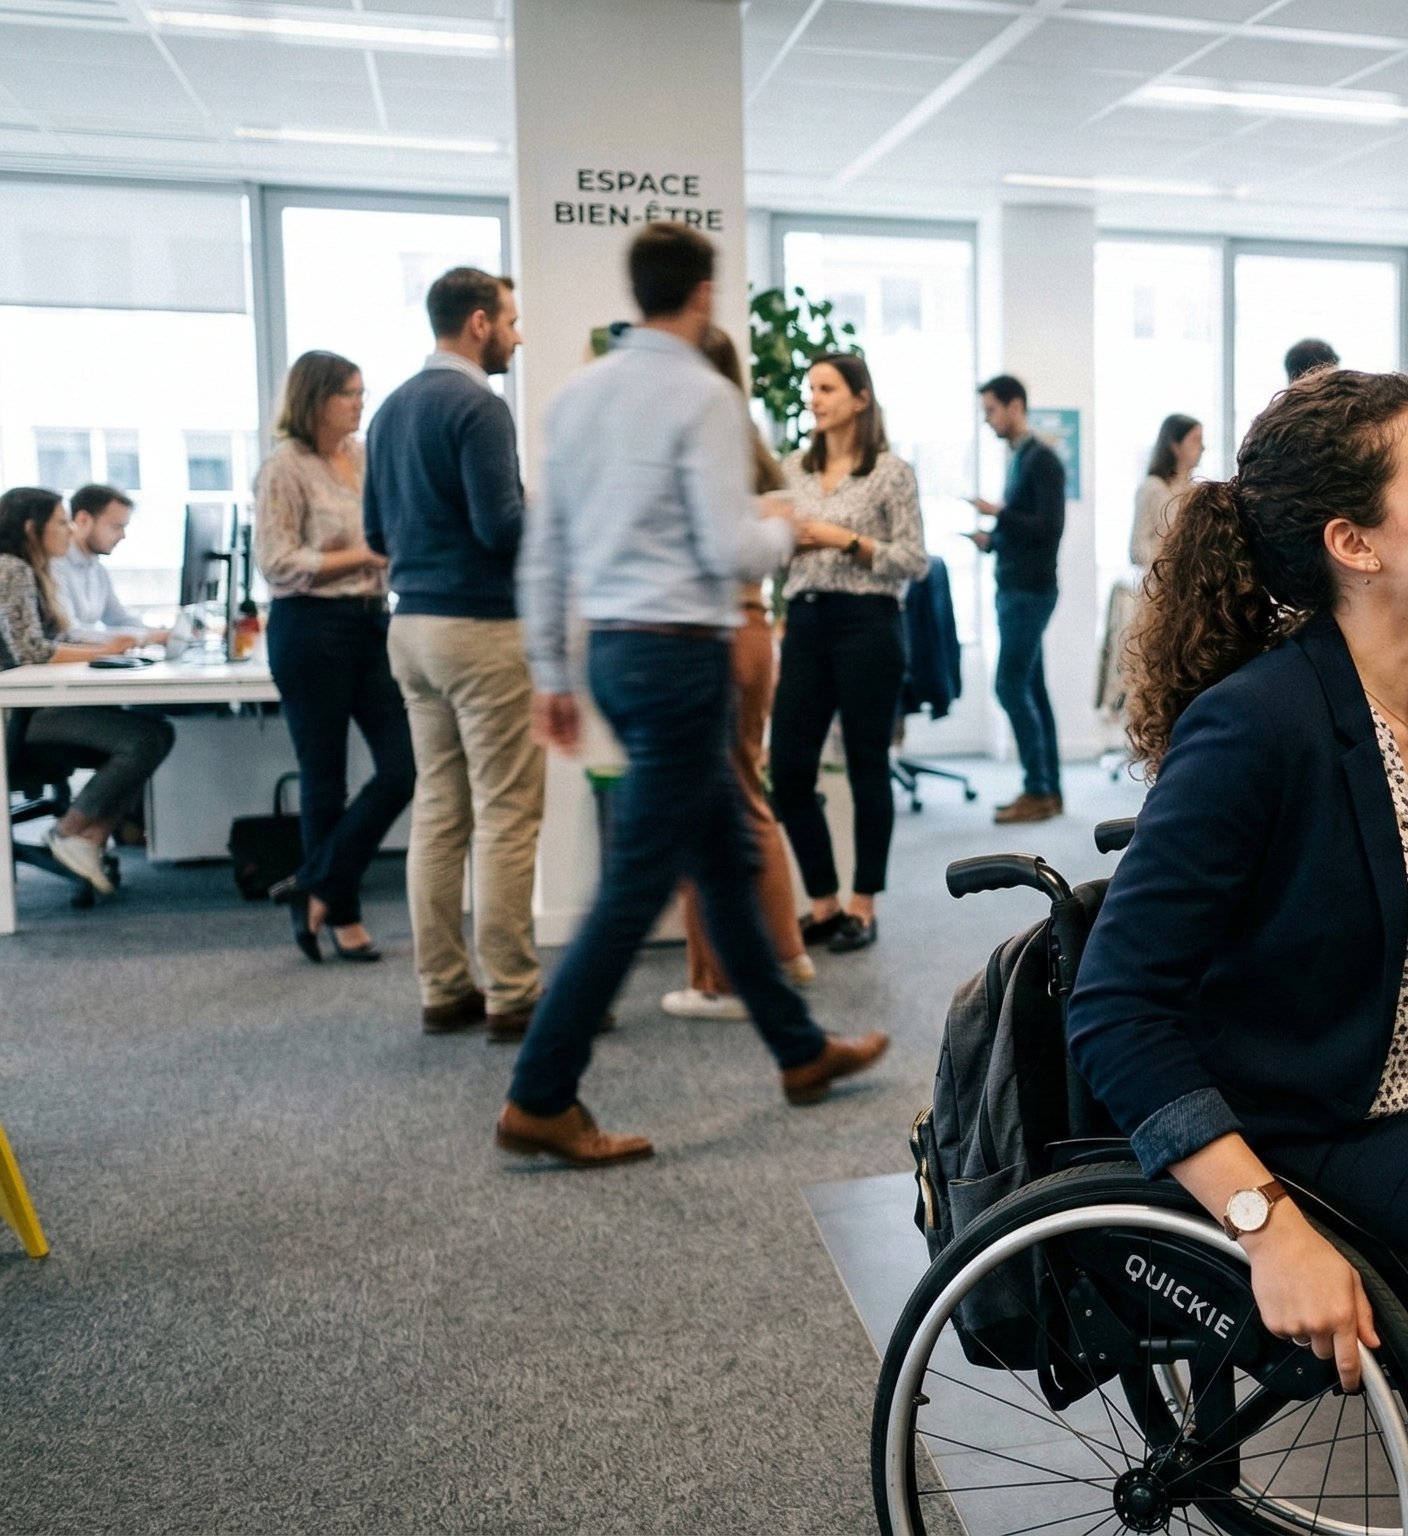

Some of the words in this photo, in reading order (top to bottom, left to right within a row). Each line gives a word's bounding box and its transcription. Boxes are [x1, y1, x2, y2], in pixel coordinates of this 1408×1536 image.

[578, 168, 701, 197] ESPACE
[555, 200, 724, 231] BIEN-ÊTRE
[1125, 1254, 1235, 1339] QUICKIE
